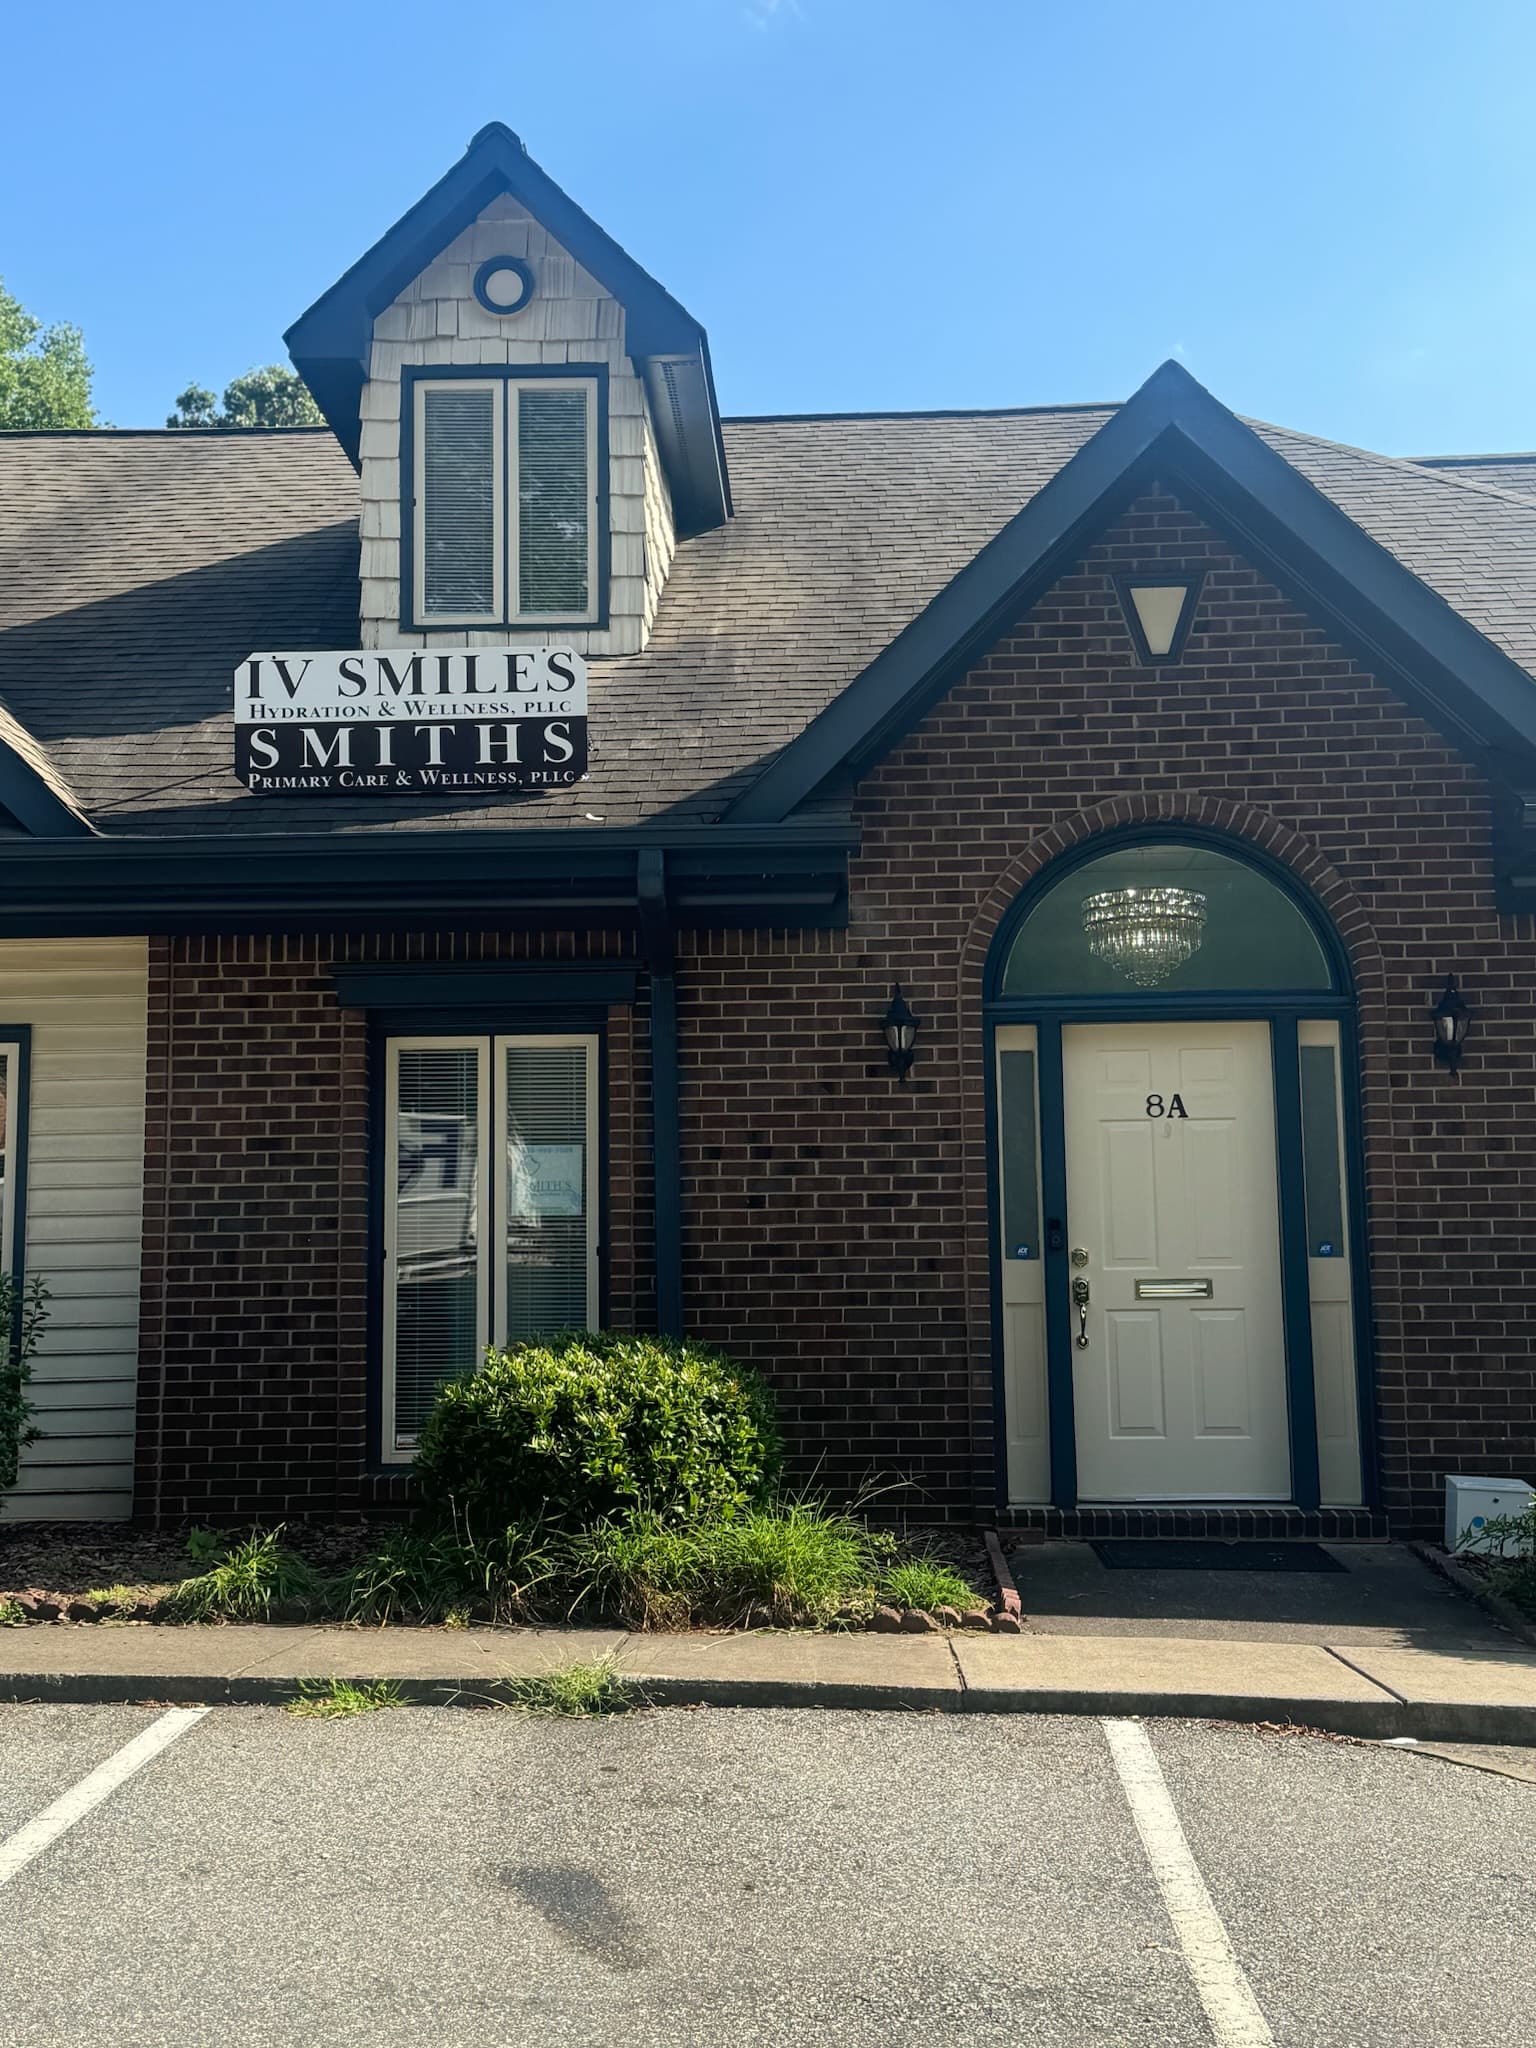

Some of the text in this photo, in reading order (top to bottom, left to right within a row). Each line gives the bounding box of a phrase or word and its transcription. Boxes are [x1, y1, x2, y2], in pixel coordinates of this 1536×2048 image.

[245, 651, 577, 699] IV SMILES
[249, 700, 573, 719] HYDRATION & WELLNESS, PLLC
[249, 721, 574, 770] SMITHS
[248, 769, 575, 789] PRIMARY CARE & WELLNESS, PLLC
[1146, 1093, 1189, 1119] 8A
